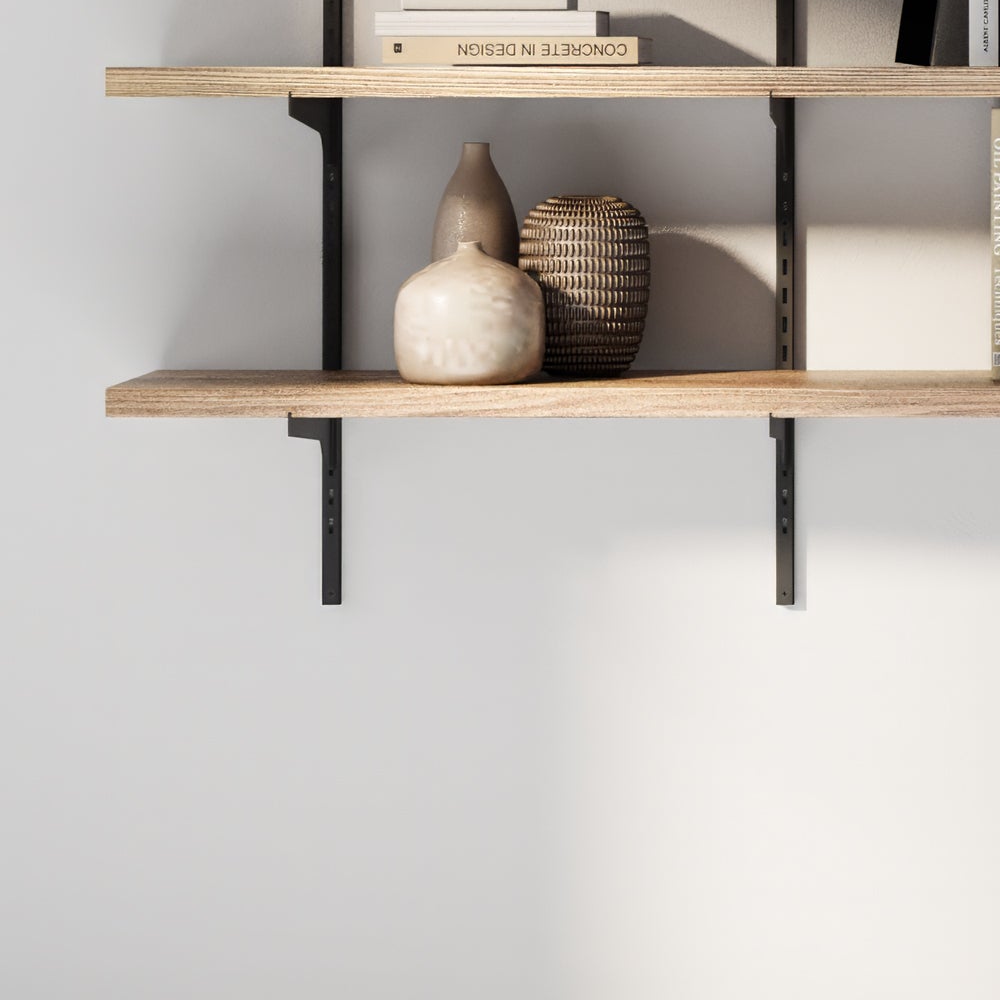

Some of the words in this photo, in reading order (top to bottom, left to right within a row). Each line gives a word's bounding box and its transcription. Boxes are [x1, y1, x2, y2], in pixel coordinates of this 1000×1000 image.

[457, 43, 516, 56] DESIGN
[521, 44, 536, 56] IN
[541, 43, 627, 56] CONCRETE
